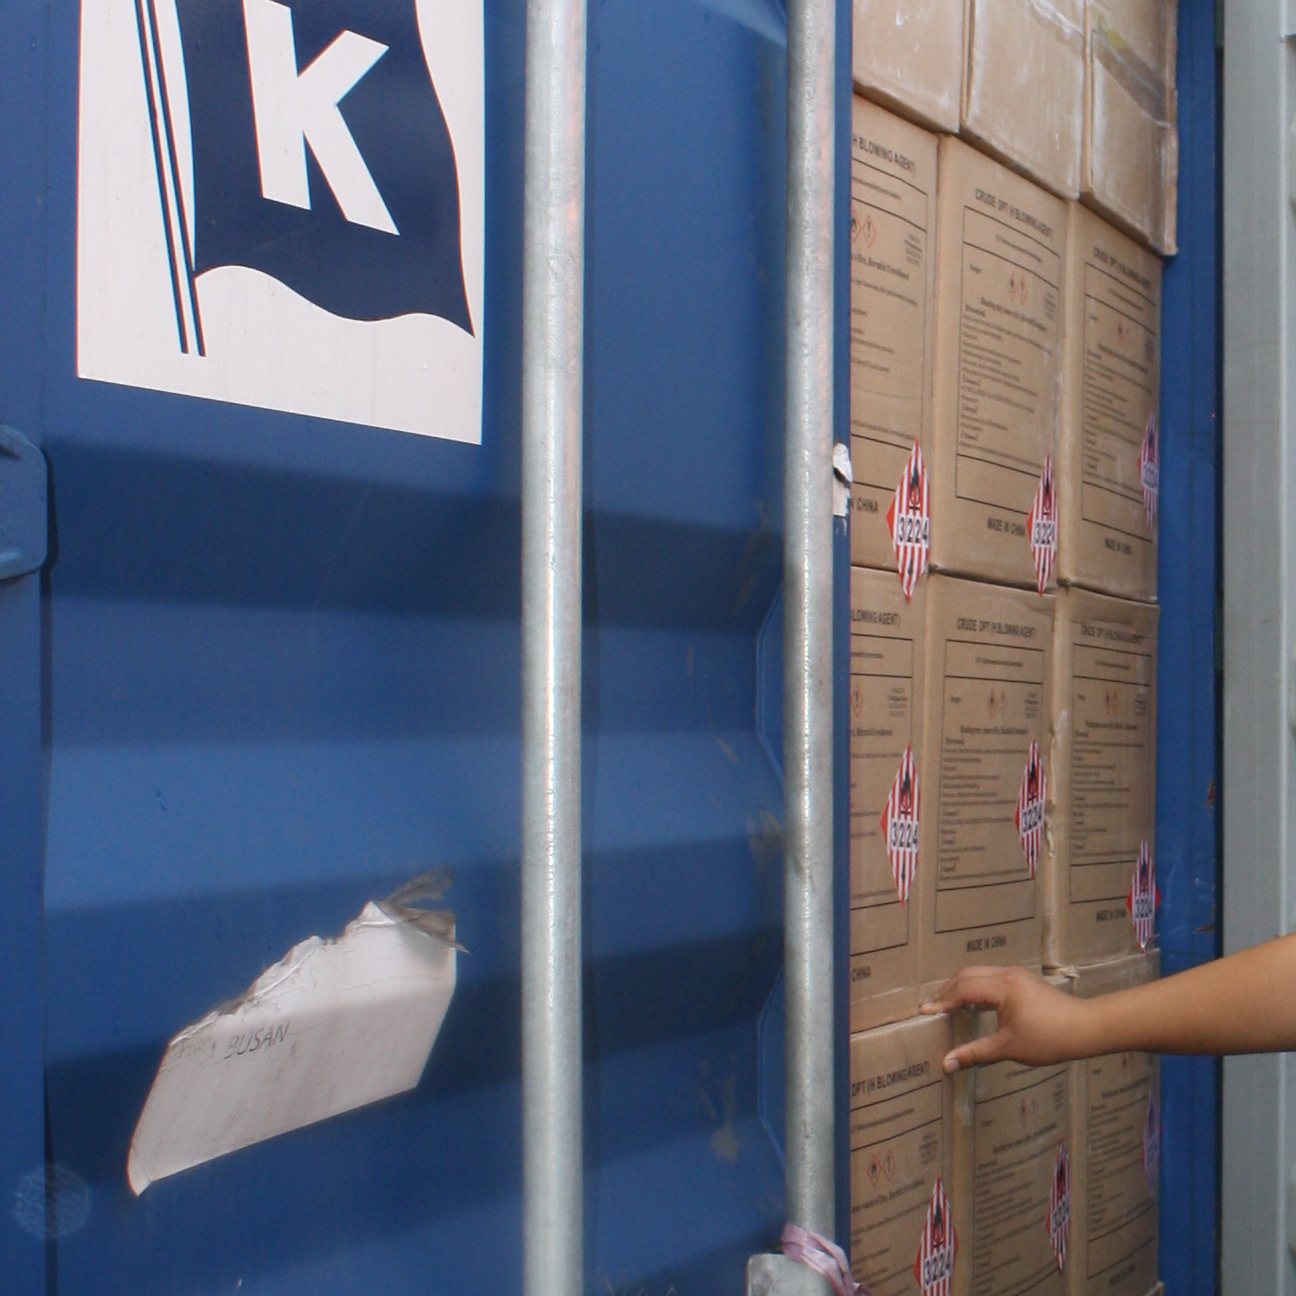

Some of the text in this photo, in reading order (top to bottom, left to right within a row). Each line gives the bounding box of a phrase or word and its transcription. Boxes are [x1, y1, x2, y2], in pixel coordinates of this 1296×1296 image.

[859, 136, 893, 163] BLOWING
[857, 497, 878, 514] CHINA
[898, 516, 929, 542] 3224
[851, 609, 878, 623] LOWING
[957, 617, 977, 632] CRUDE
[1022, 803, 1042, 833] 3224
[892, 821, 918, 848] 3224
[966, 938, 983, 953] MADE
[223, 1021, 290, 1060] BUSAN
[925, 1247, 951, 1286] 3224
